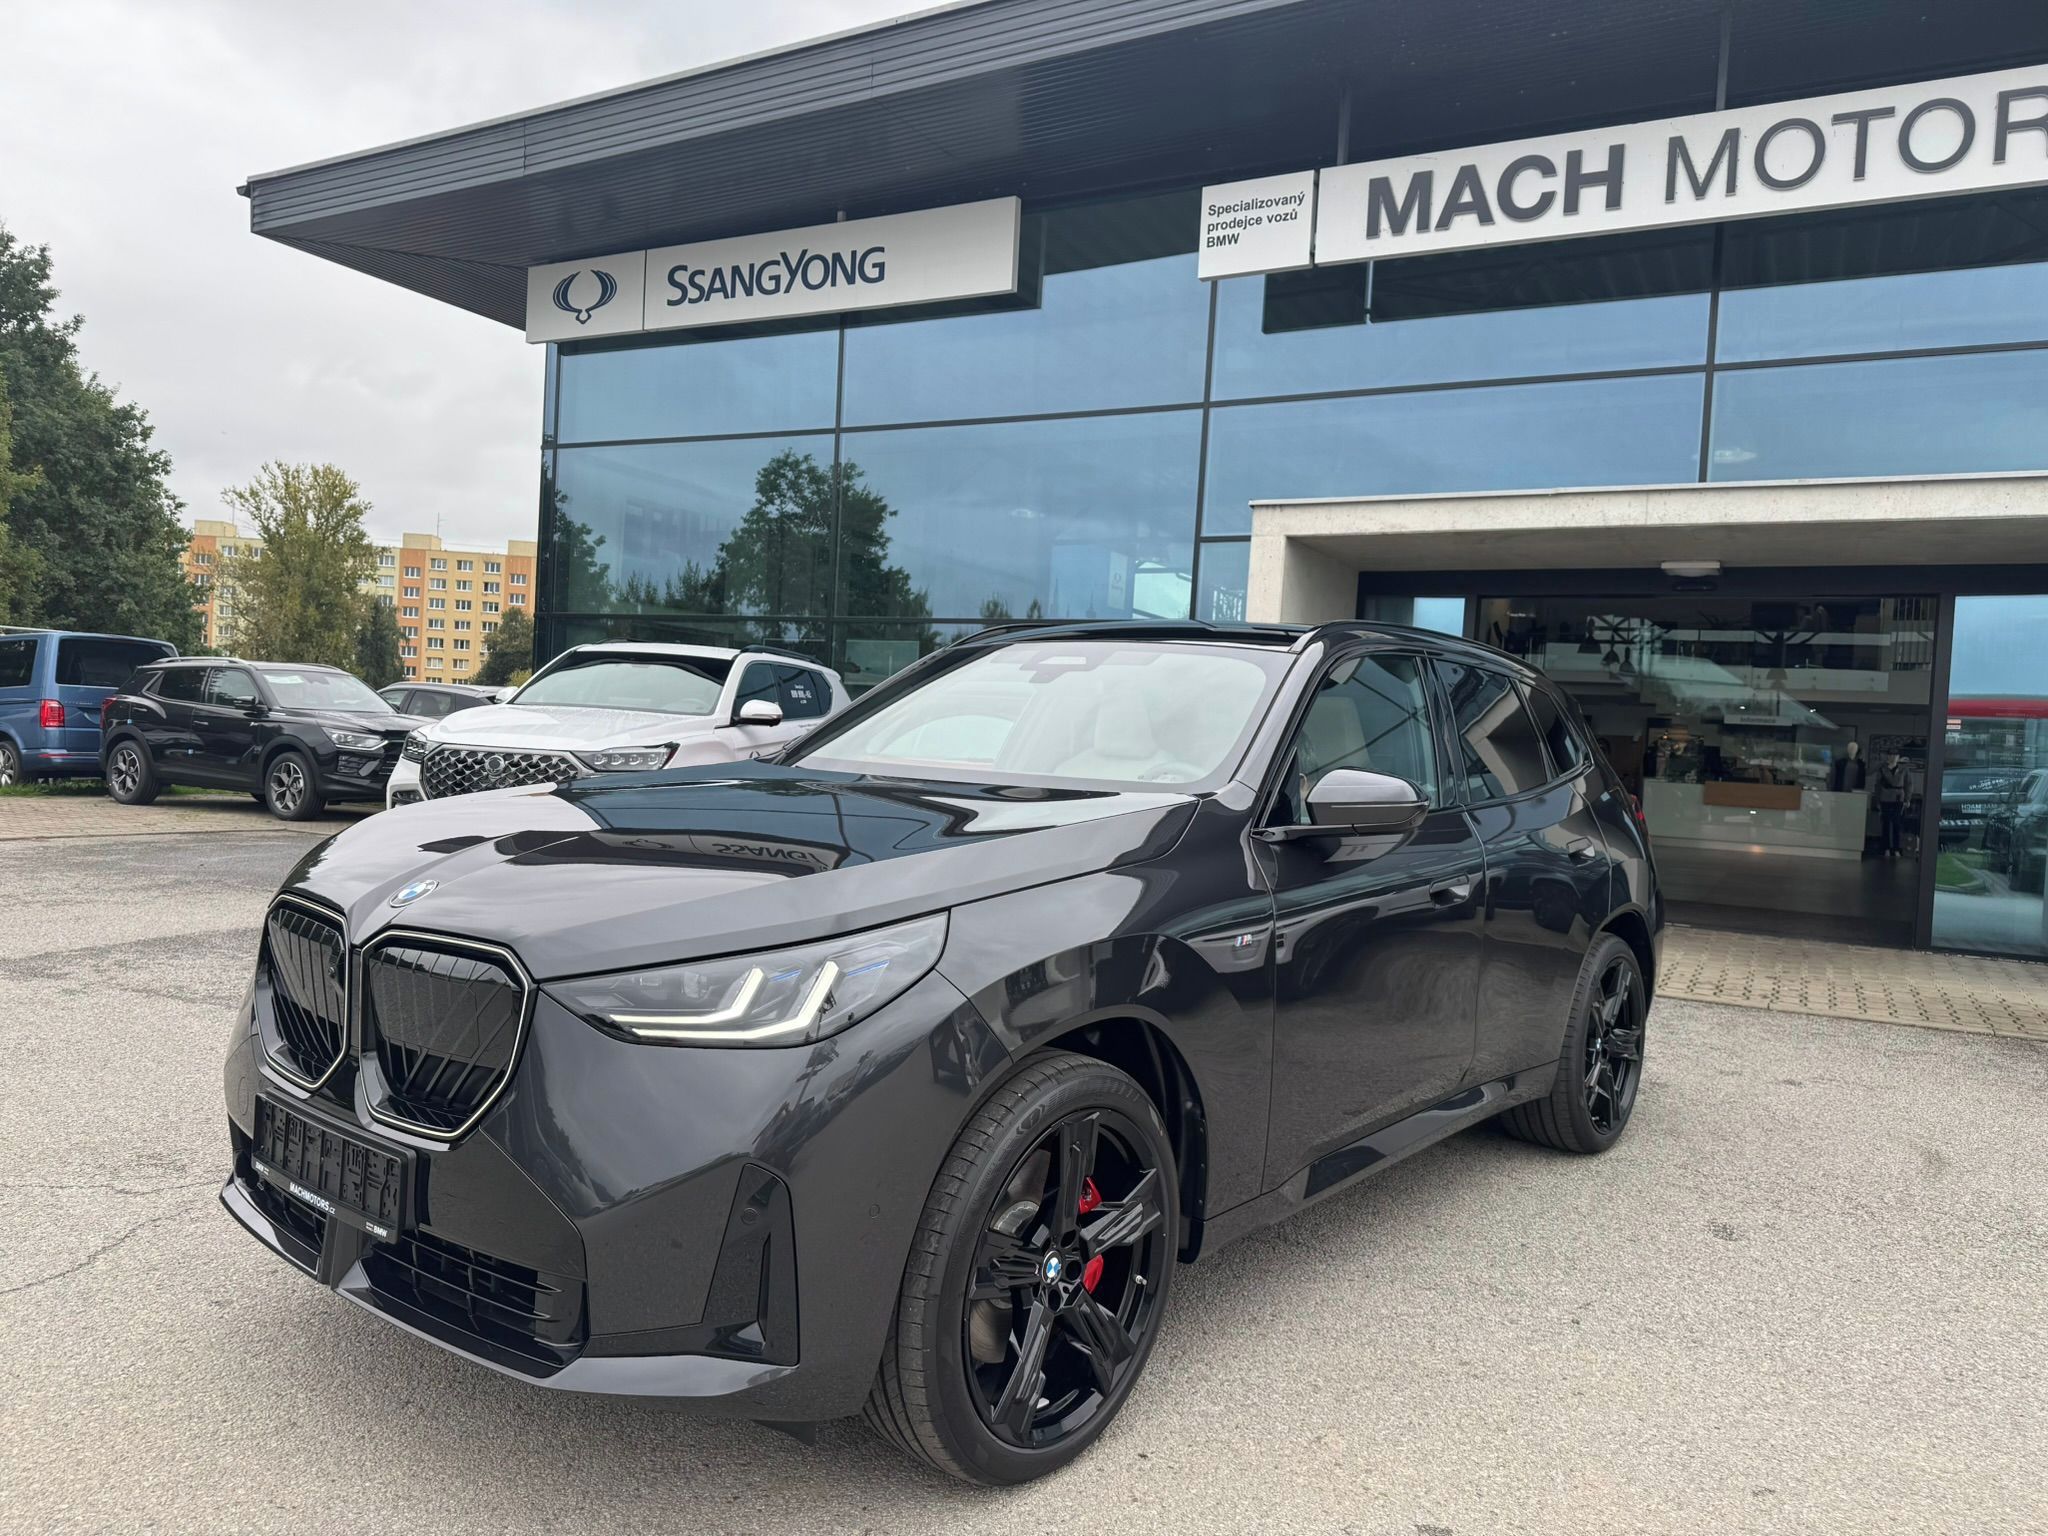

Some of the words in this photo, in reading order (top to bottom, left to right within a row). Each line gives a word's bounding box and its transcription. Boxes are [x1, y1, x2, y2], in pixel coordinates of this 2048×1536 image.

[1366, 143, 1625, 239] MACH
[1665, 85, 2048, 204] MOTOR
[1208, 191, 1305, 217] Specializovaný
[1207, 215, 1263, 235] prodejce
[1267, 208, 1298, 223] vozů
[1206, 233, 1240, 248] BMW
[373, 1225, 388, 1238] BMW
